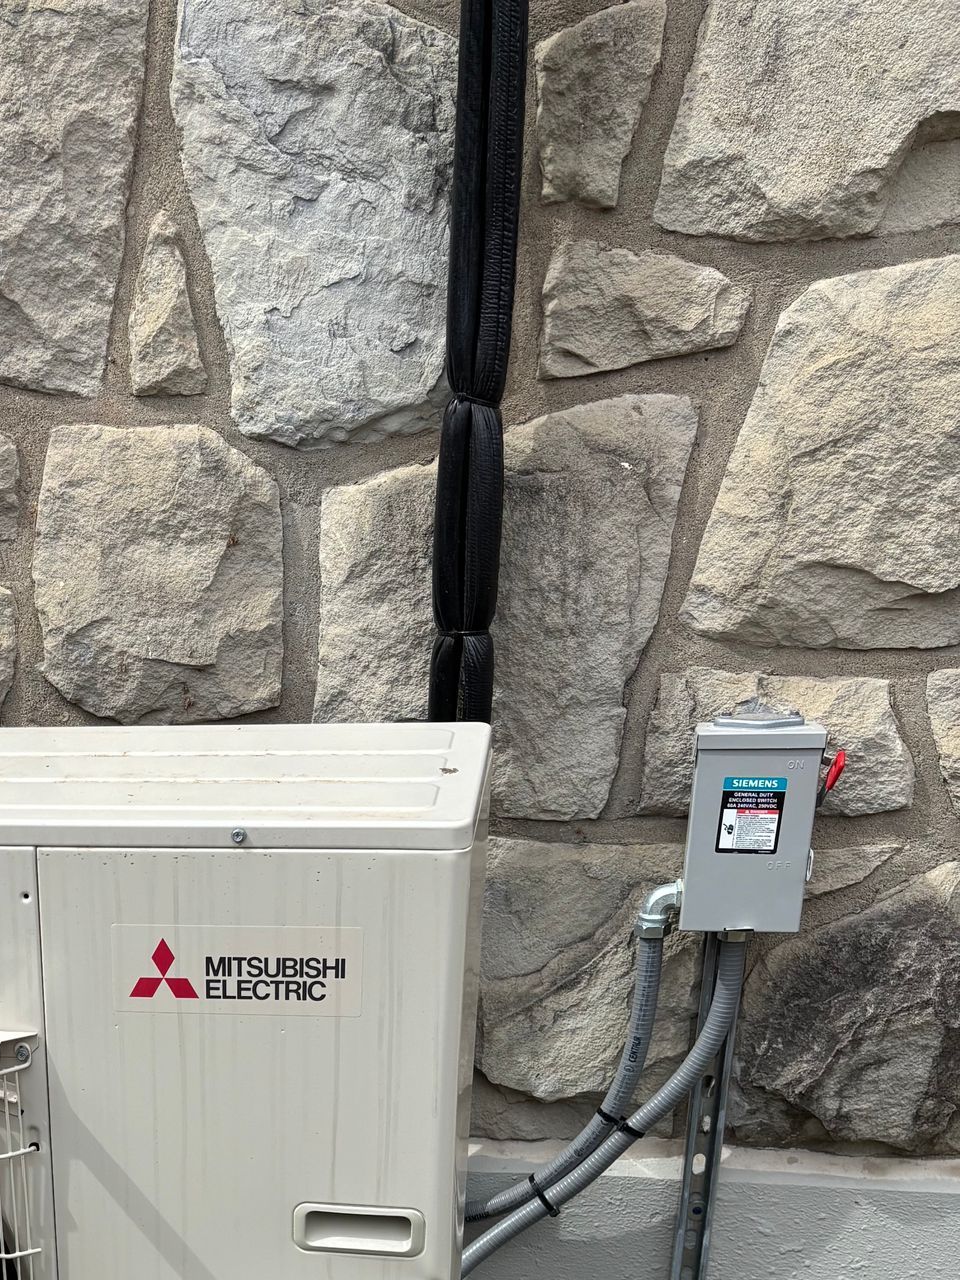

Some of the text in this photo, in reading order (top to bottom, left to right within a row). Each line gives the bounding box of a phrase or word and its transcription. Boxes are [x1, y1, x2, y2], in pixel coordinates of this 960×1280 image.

[788, 759, 804, 769] ON
[732, 779, 778, 788] SIEMENS
[205, 956, 346, 979] MITSUBISHI
[205, 979, 327, 1001] ELECTRIC
